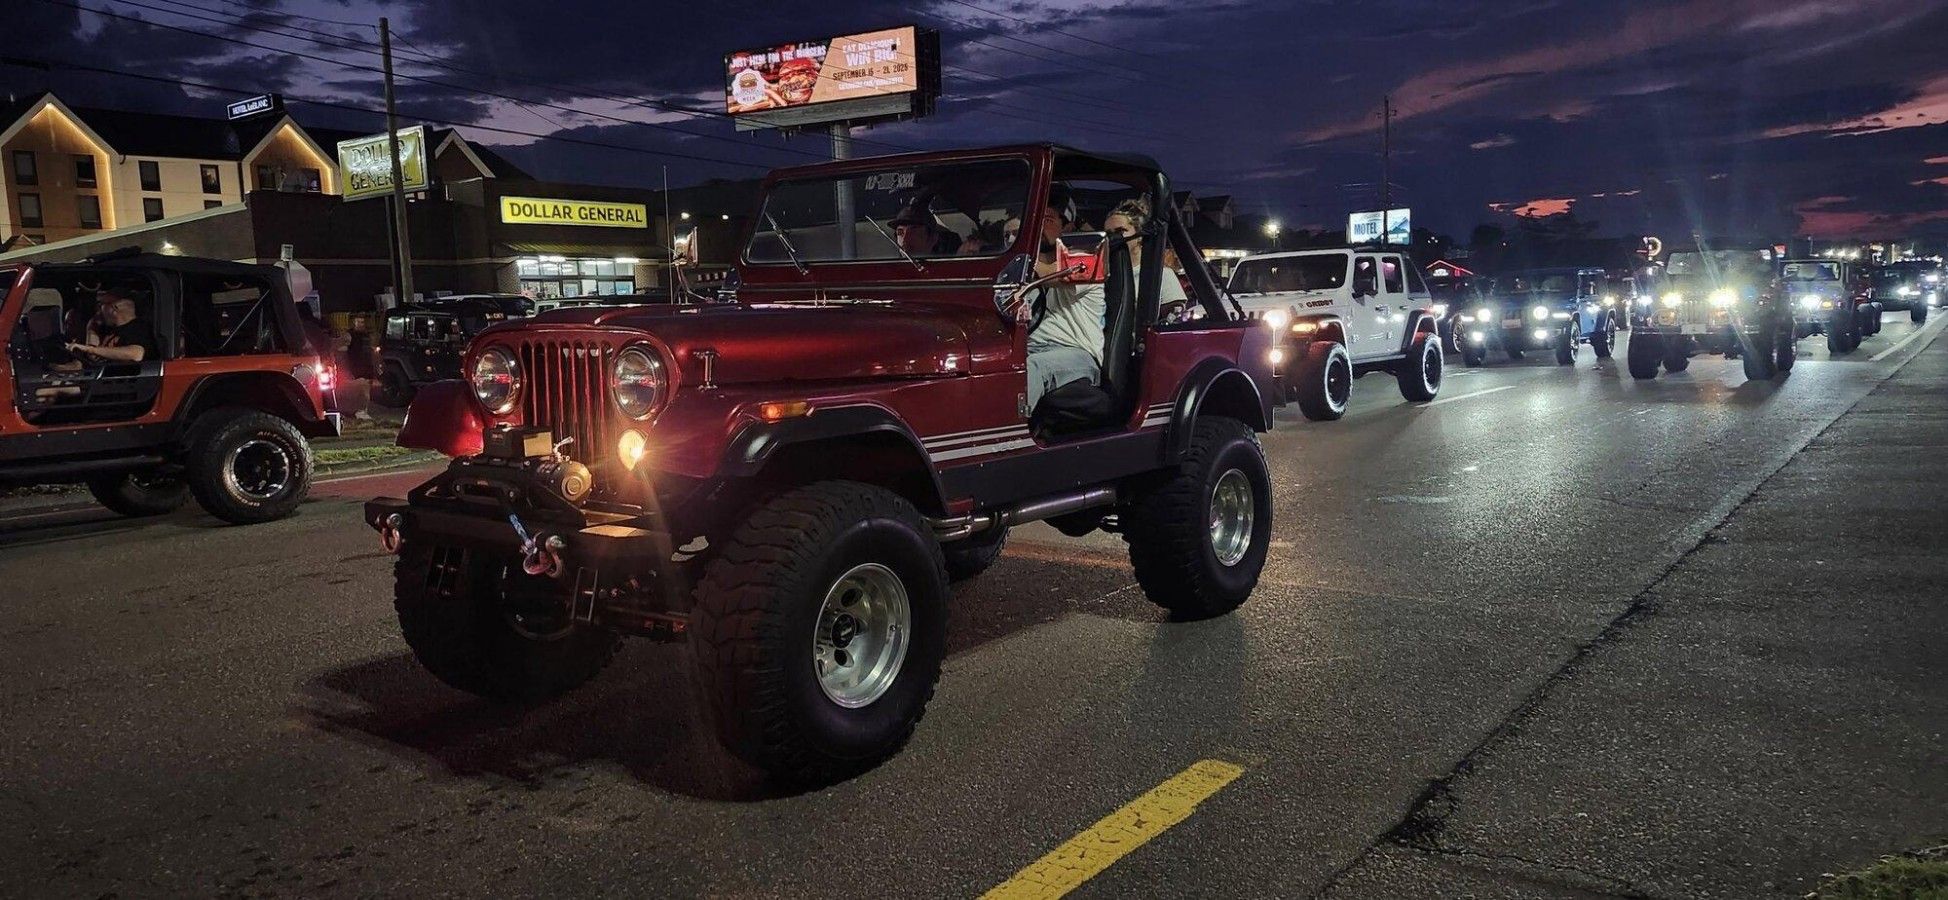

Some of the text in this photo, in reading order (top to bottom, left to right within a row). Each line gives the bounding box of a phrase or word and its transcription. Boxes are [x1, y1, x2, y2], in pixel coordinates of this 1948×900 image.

[845, 50, 871, 66] WIN
[832, 68, 867, 80] SEPTEMBER
[509, 202, 643, 223] DOLLAR GENERAL
[1354, 221, 1378, 236] MOTEL
